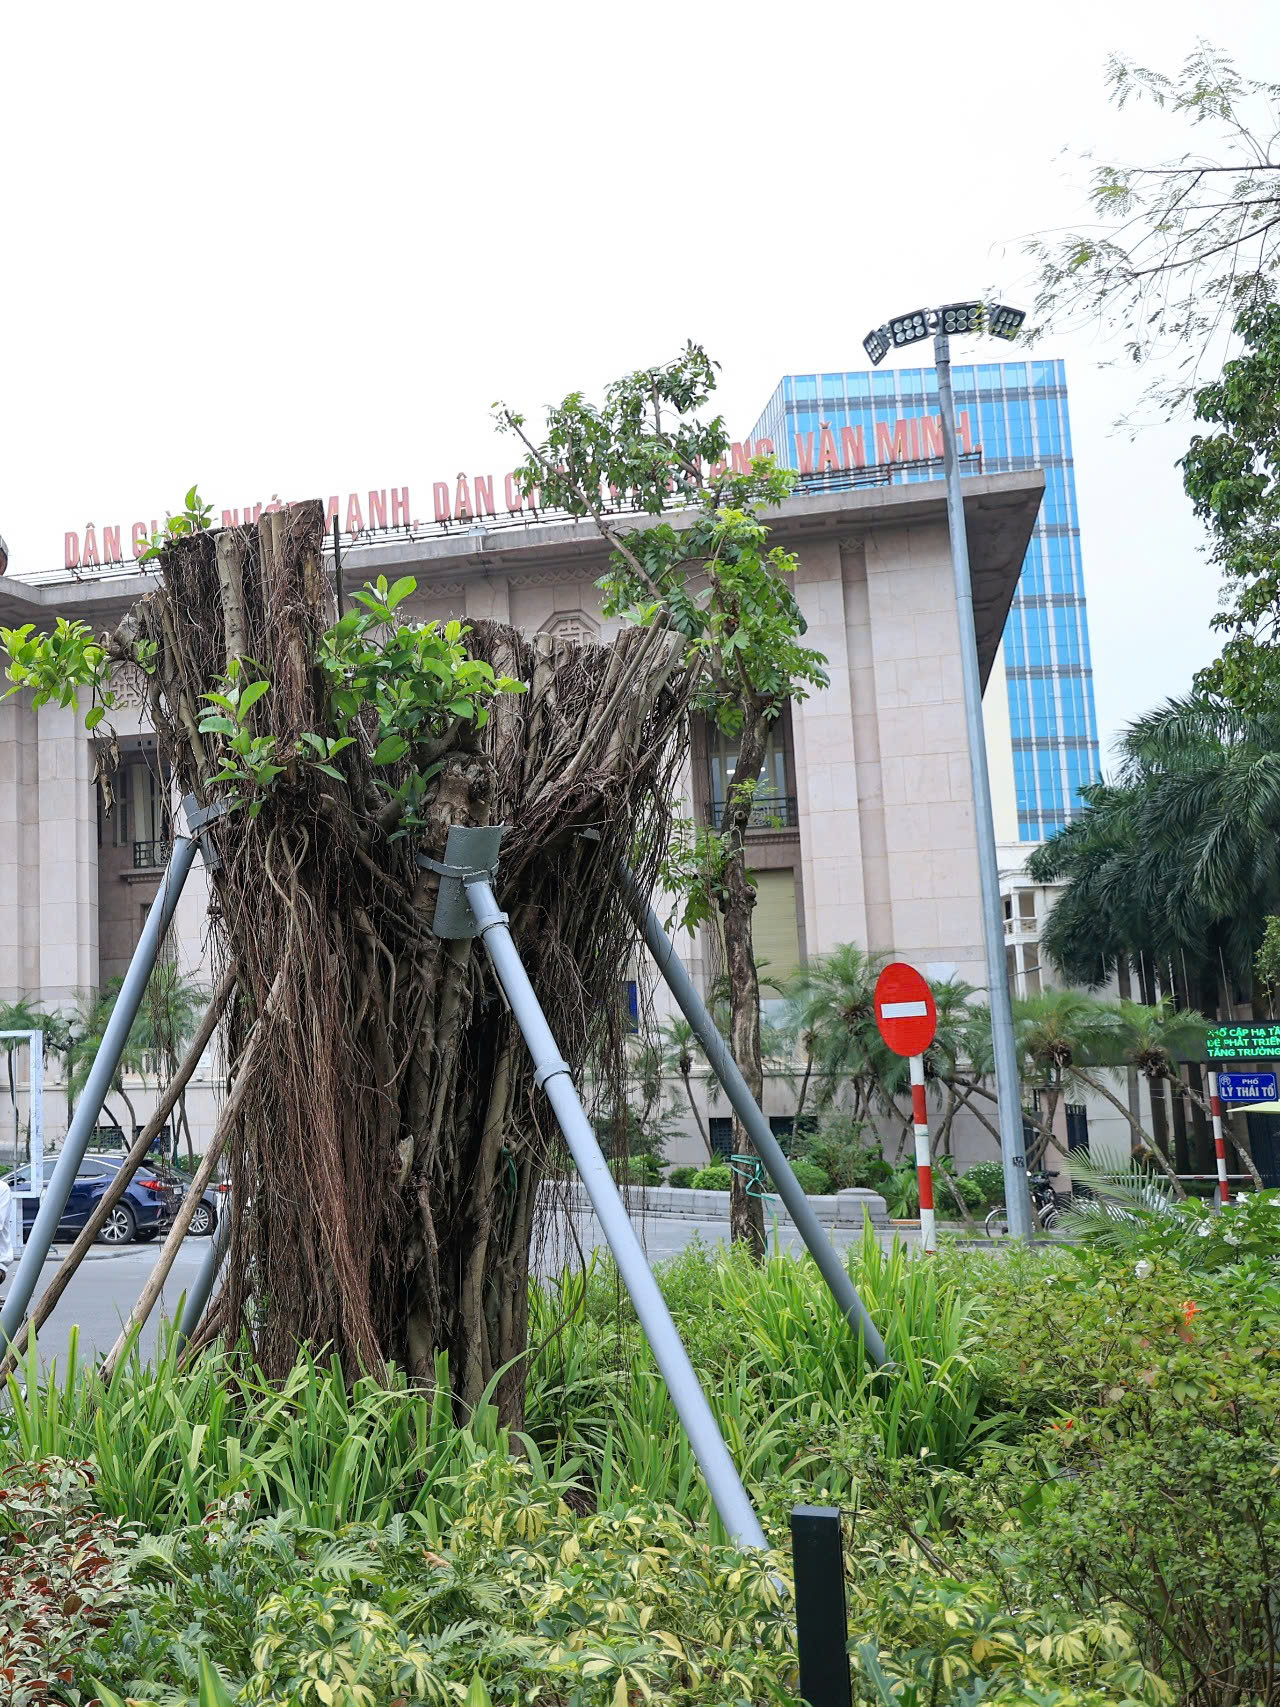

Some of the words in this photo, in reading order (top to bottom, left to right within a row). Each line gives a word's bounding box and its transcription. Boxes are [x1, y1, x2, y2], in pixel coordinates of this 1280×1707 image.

[65, 521, 121, 569] DÂN
[433, 471, 495, 521] DÂN
[795, 420, 866, 475] VĂN
[1207, 1047, 1236, 1057] TĂNG
[1242, 1077, 1260, 1085] PHỐ
[1221, 1085, 1233, 1097] LÝ
[1236, 1084, 1260, 1097] THÁI
[1261, 1082, 1275, 1097] TỔ
